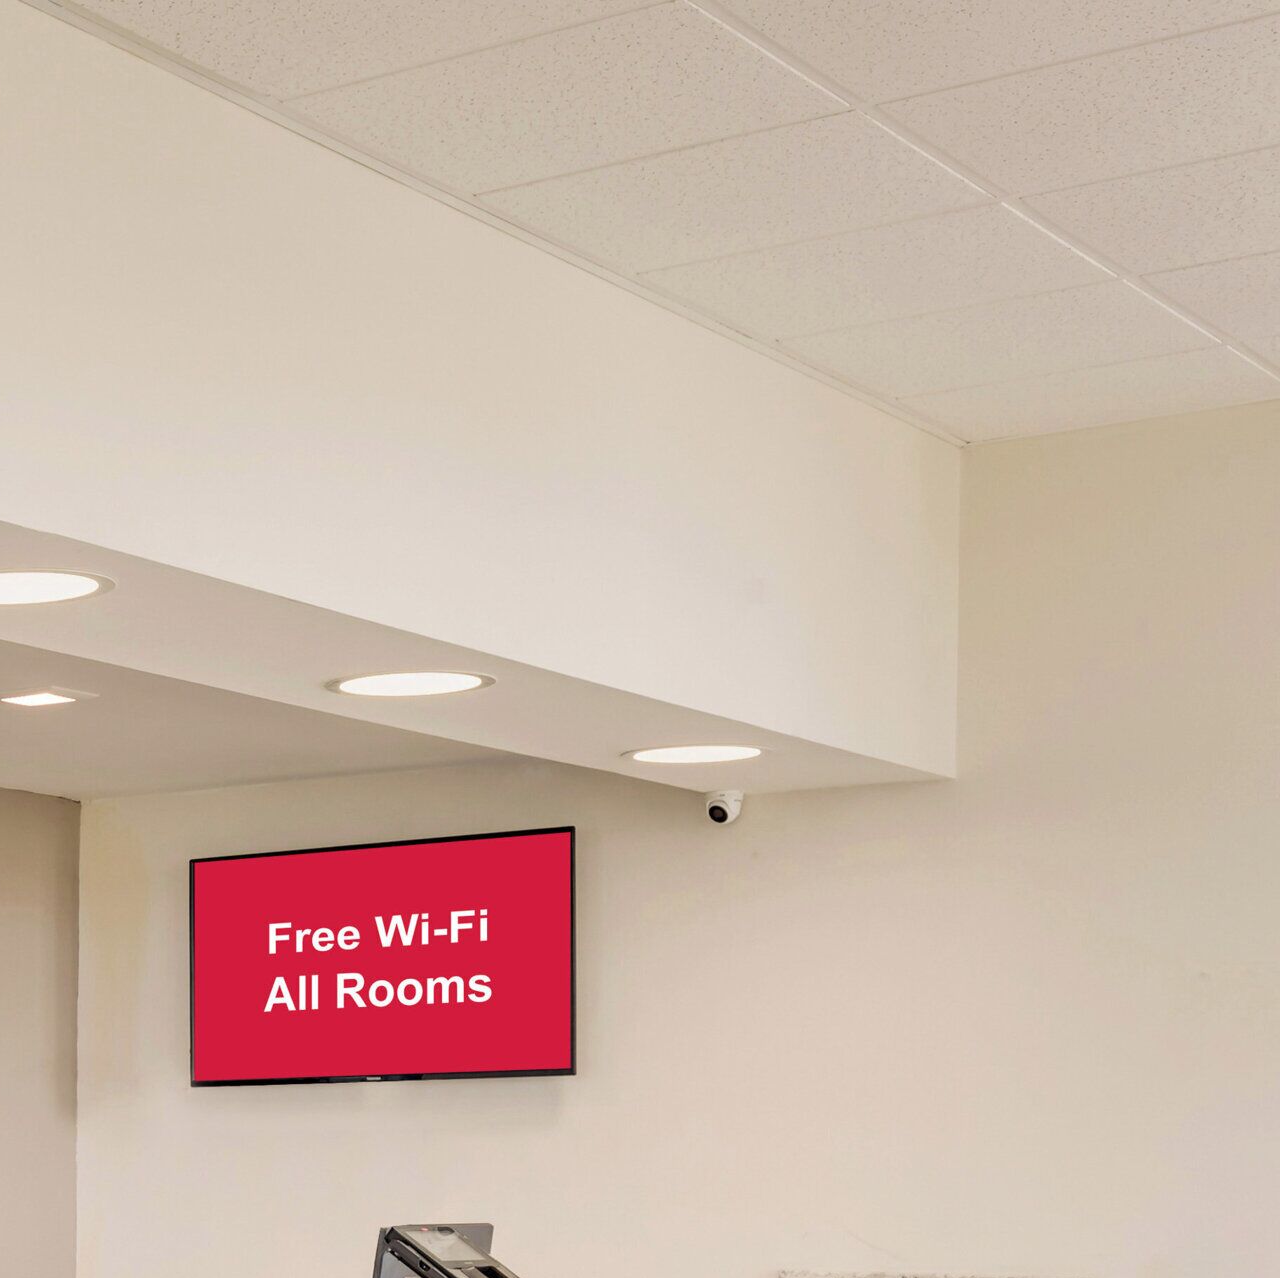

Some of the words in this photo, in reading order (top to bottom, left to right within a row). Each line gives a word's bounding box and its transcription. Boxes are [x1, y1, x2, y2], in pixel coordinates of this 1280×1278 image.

[268, 921, 361, 955] Free
[374, 908, 488, 948] Wi-Fi
[263, 974, 319, 1013] All
[336, 972, 493, 1009] Rooms
